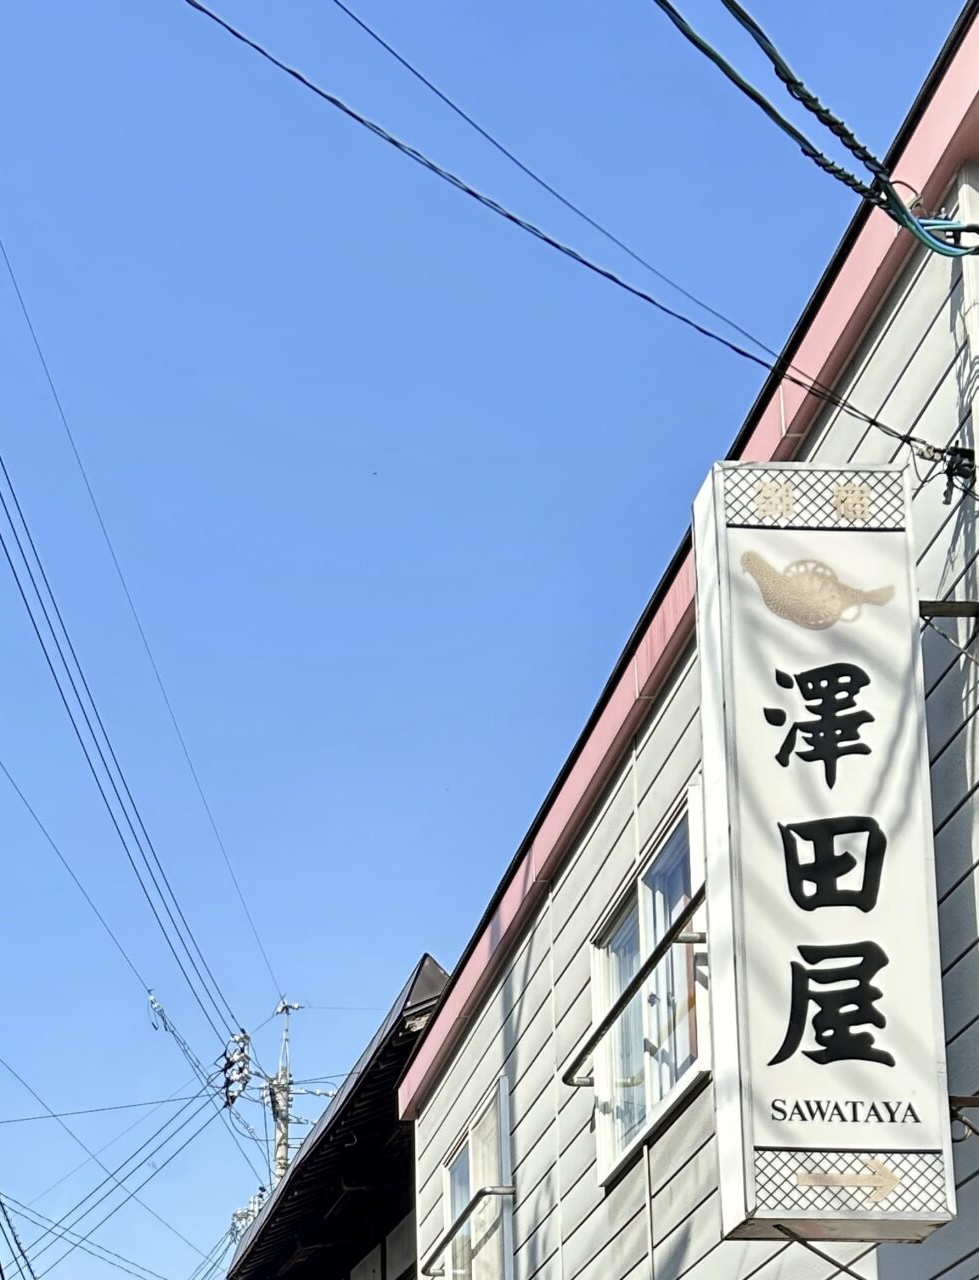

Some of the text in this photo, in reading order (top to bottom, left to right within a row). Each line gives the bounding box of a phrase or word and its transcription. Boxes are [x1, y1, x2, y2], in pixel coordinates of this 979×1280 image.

[763, 662, 896, 1067] 澤田屋
[770, 1098, 922, 1124] SAWATAYA
